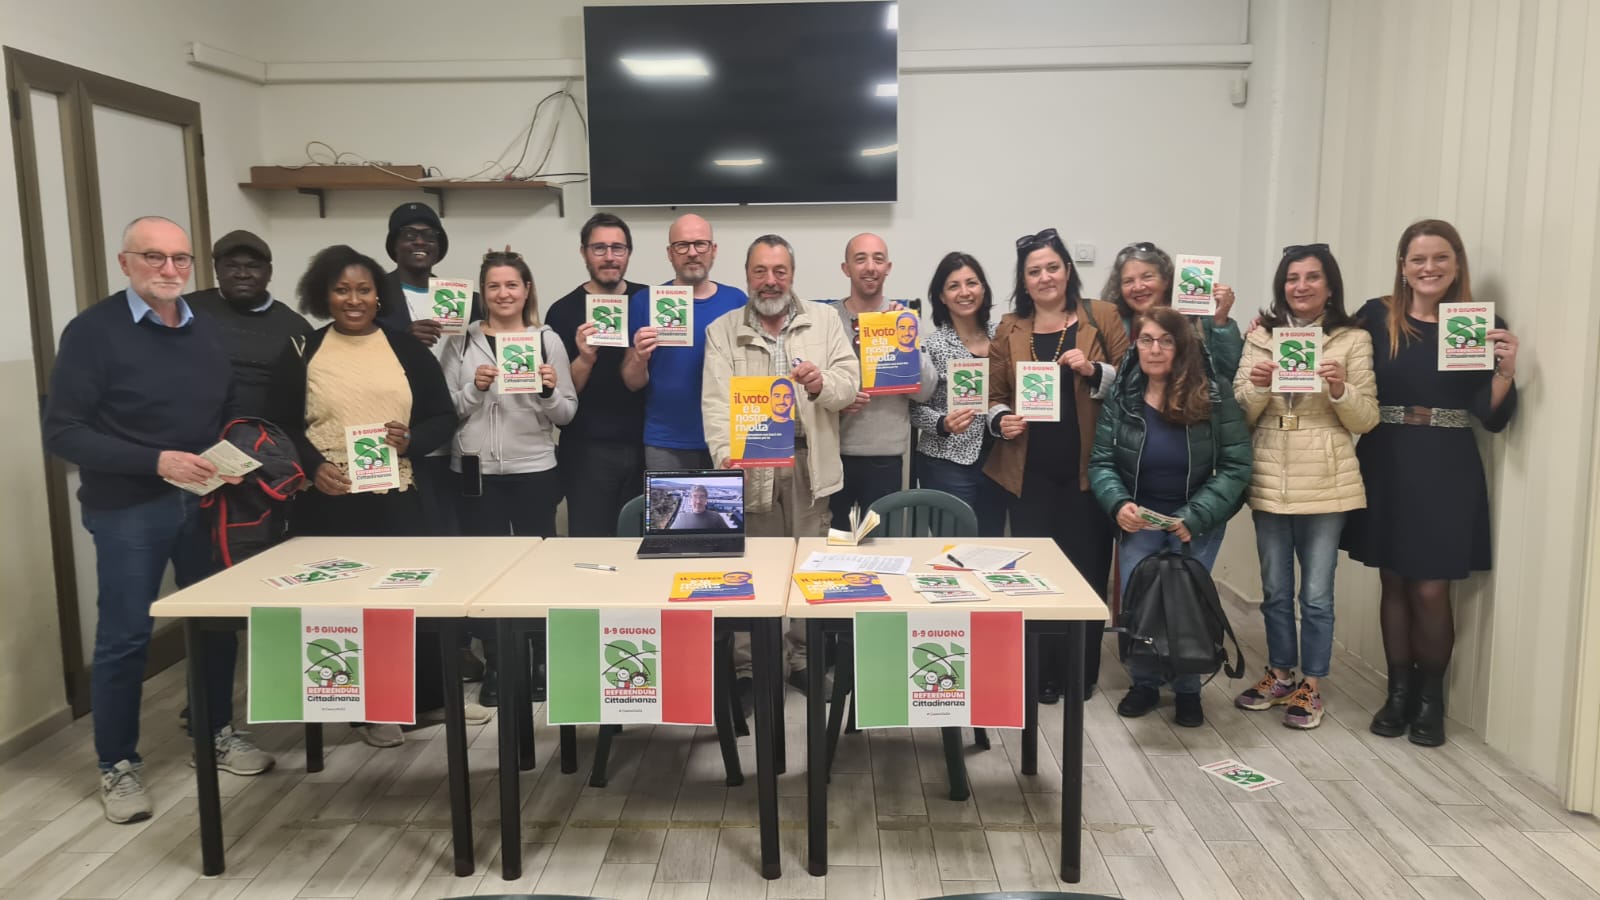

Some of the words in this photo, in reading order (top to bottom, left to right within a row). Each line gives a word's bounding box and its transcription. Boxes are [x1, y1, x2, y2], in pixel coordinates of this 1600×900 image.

[872, 328, 896, 337] voto
[733, 392, 741, 404] il
[742, 394, 770, 404] voto
[321, 626, 358, 634] GIUGNO
[604, 627, 618, 635] 8-9
[619, 627, 656, 635] GIUGNO
